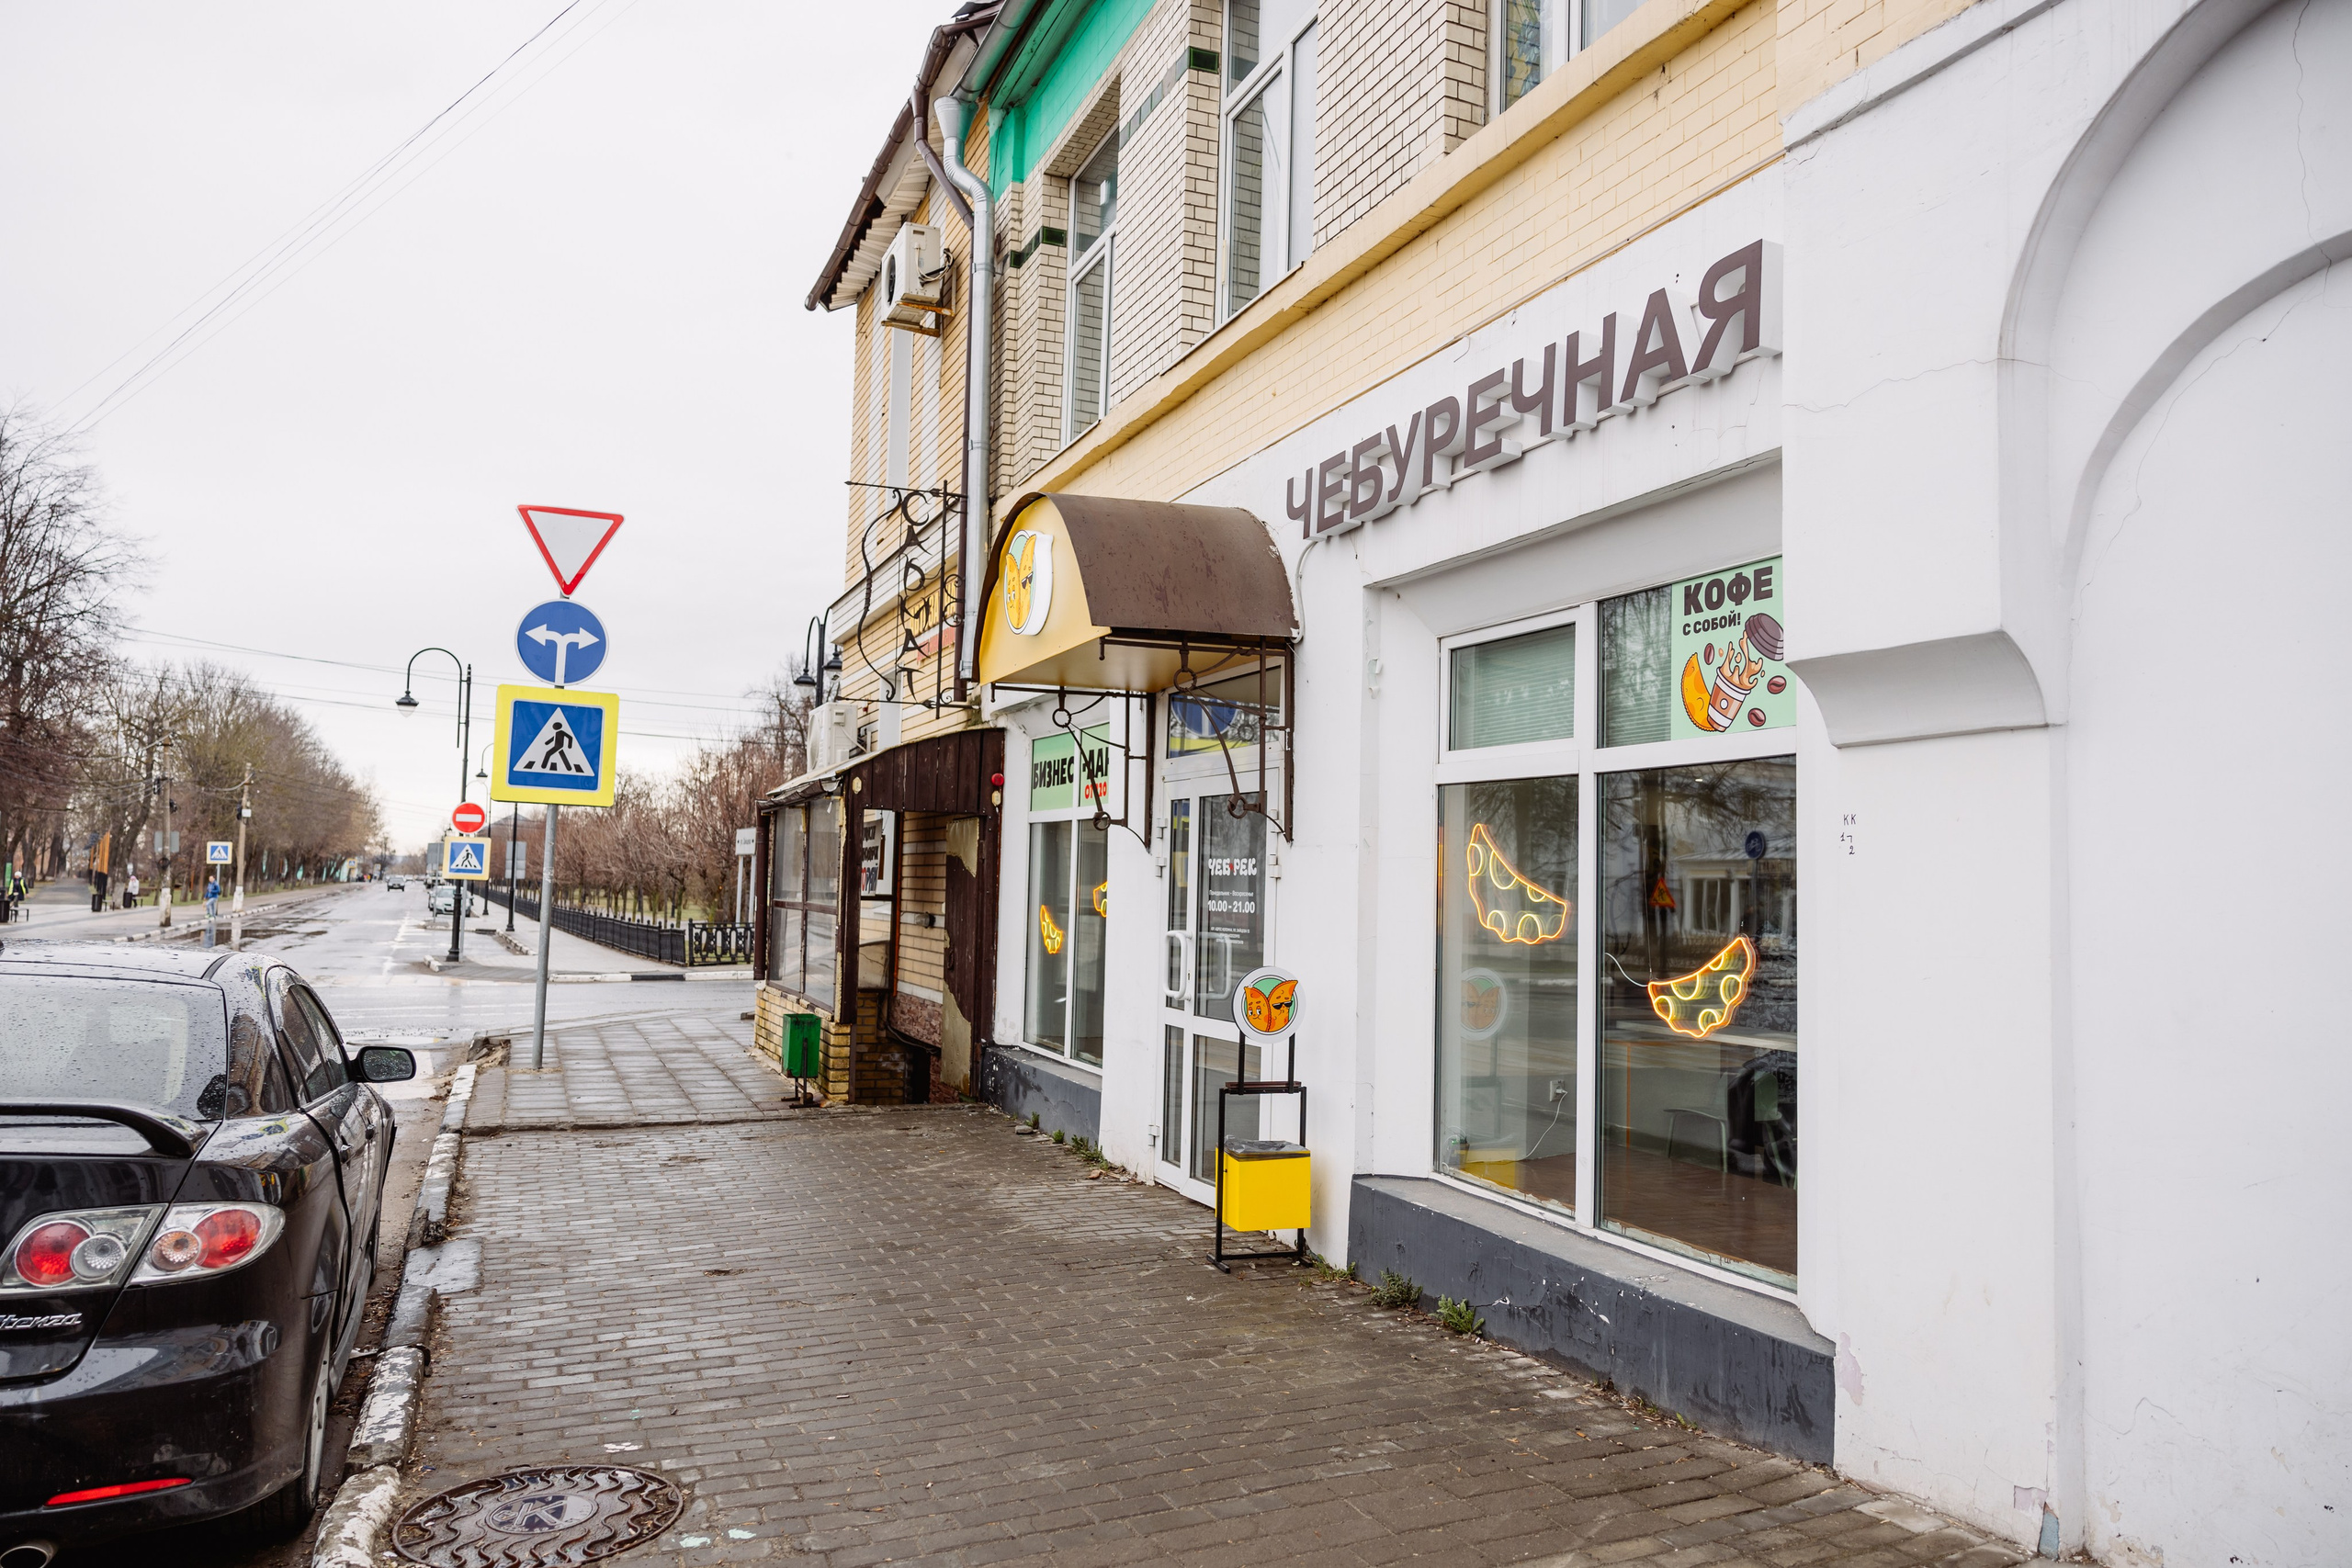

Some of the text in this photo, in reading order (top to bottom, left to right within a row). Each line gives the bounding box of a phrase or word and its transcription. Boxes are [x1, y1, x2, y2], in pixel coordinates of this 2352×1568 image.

[1286, 239, 1764, 541] ЧЕБУРЕЧНАЯ
[1683, 566, 1773, 616] КОФЕ
[1682, 610, 1741, 636] С СОБОЙ!
[0, 1313, 83, 1330] tenza
